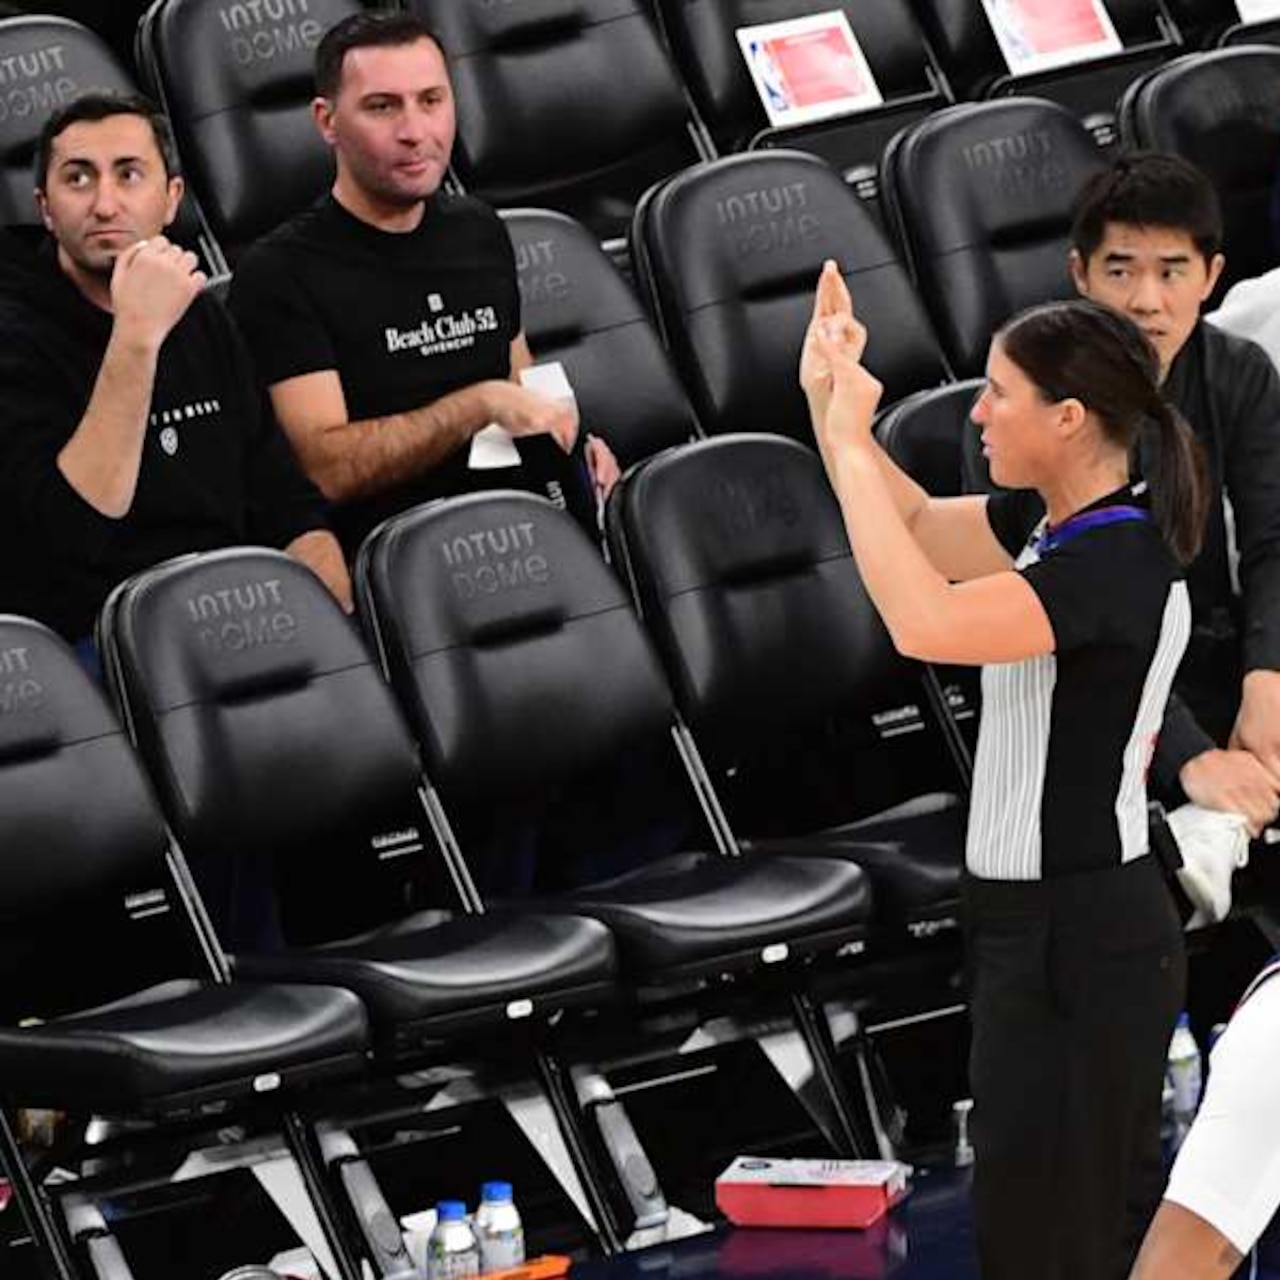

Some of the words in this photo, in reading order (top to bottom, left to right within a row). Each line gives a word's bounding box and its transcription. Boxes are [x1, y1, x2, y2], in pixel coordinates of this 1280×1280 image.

[0, 44, 67, 81] TUIT
[715, 182, 807, 223] INTUIT
[385, 321, 436, 352] Beach
[435, 312, 476, 339] Club
[441, 522, 536, 566] INTUIT
[452, 554, 550, 599] DOME
[187, 579, 283, 622] INTUIT
